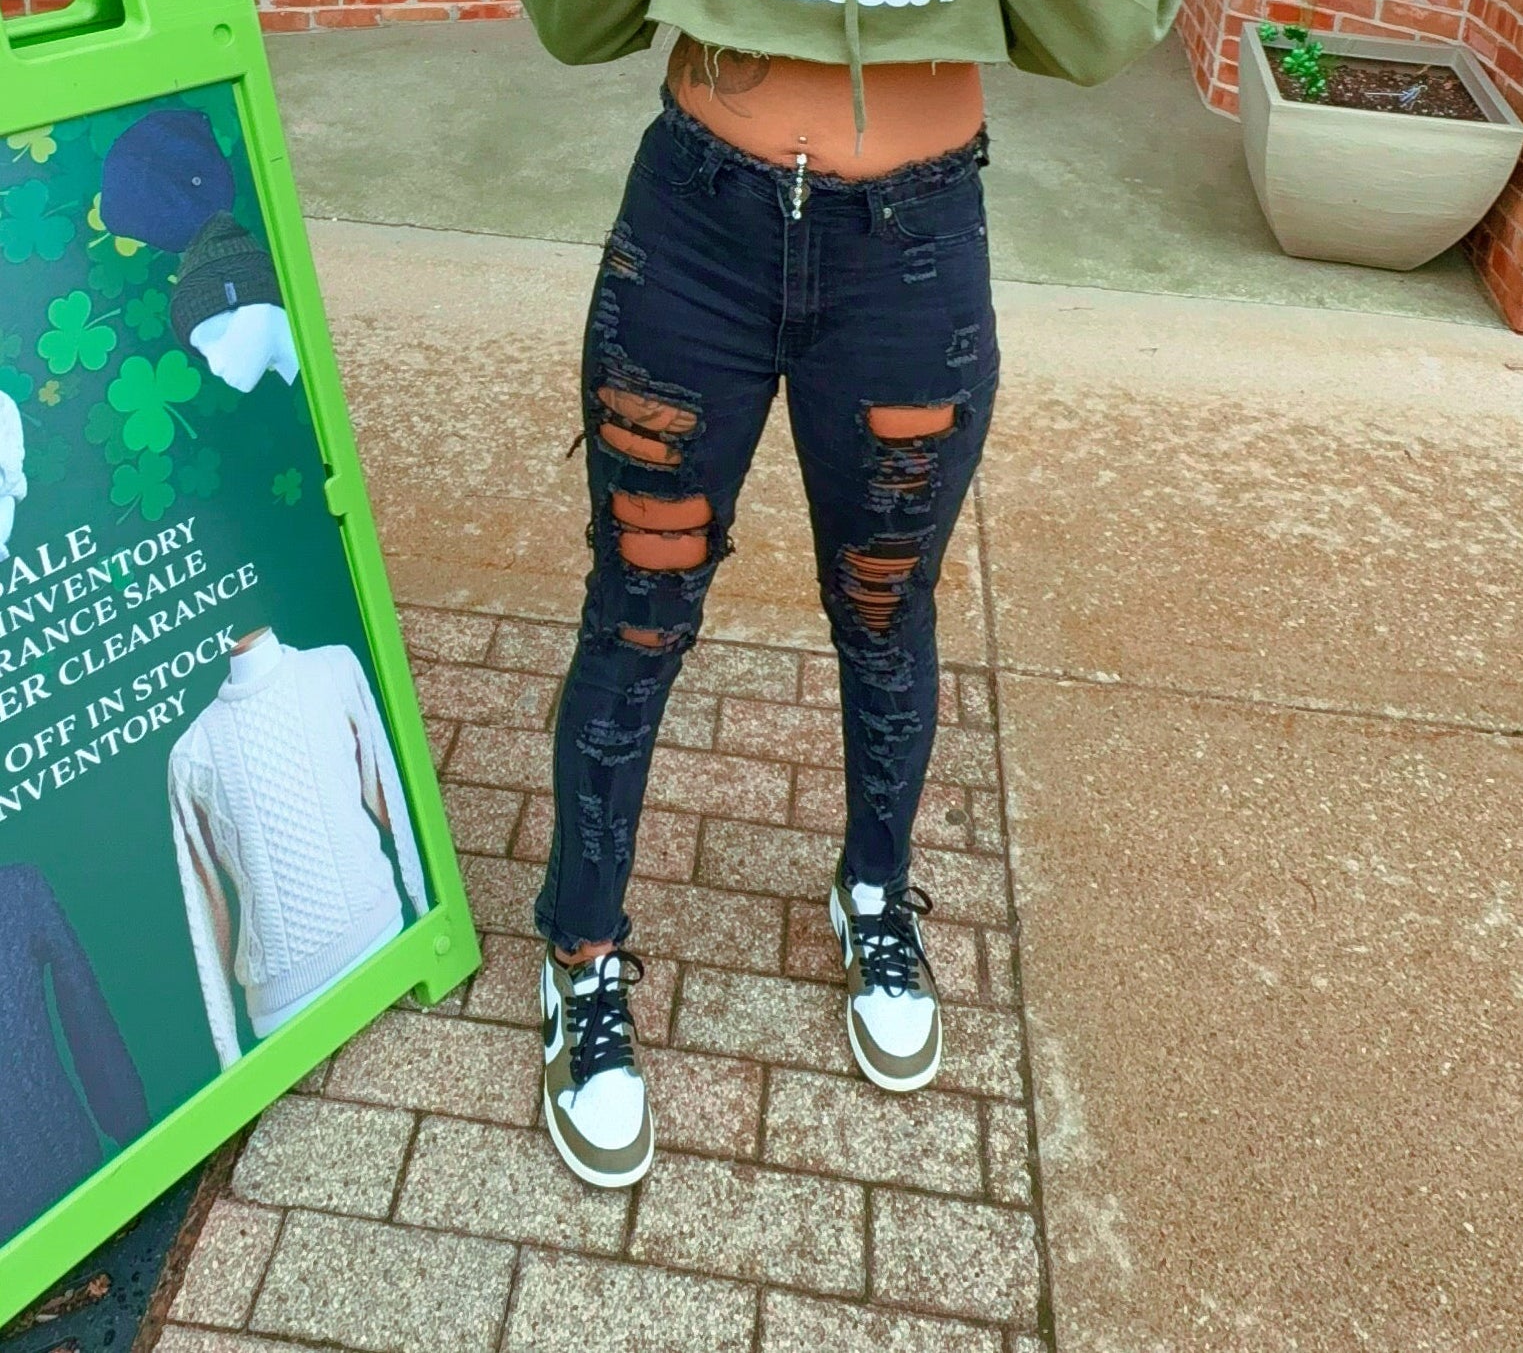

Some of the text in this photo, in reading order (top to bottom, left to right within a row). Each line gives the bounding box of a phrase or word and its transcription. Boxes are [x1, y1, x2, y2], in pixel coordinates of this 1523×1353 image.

[0, 524, 98, 596] ALE
[123, 549, 207, 609] SALE
[58, 562, 259, 686] CLEARANCE
[4, 624, 240, 773] OFF IN STOCK
